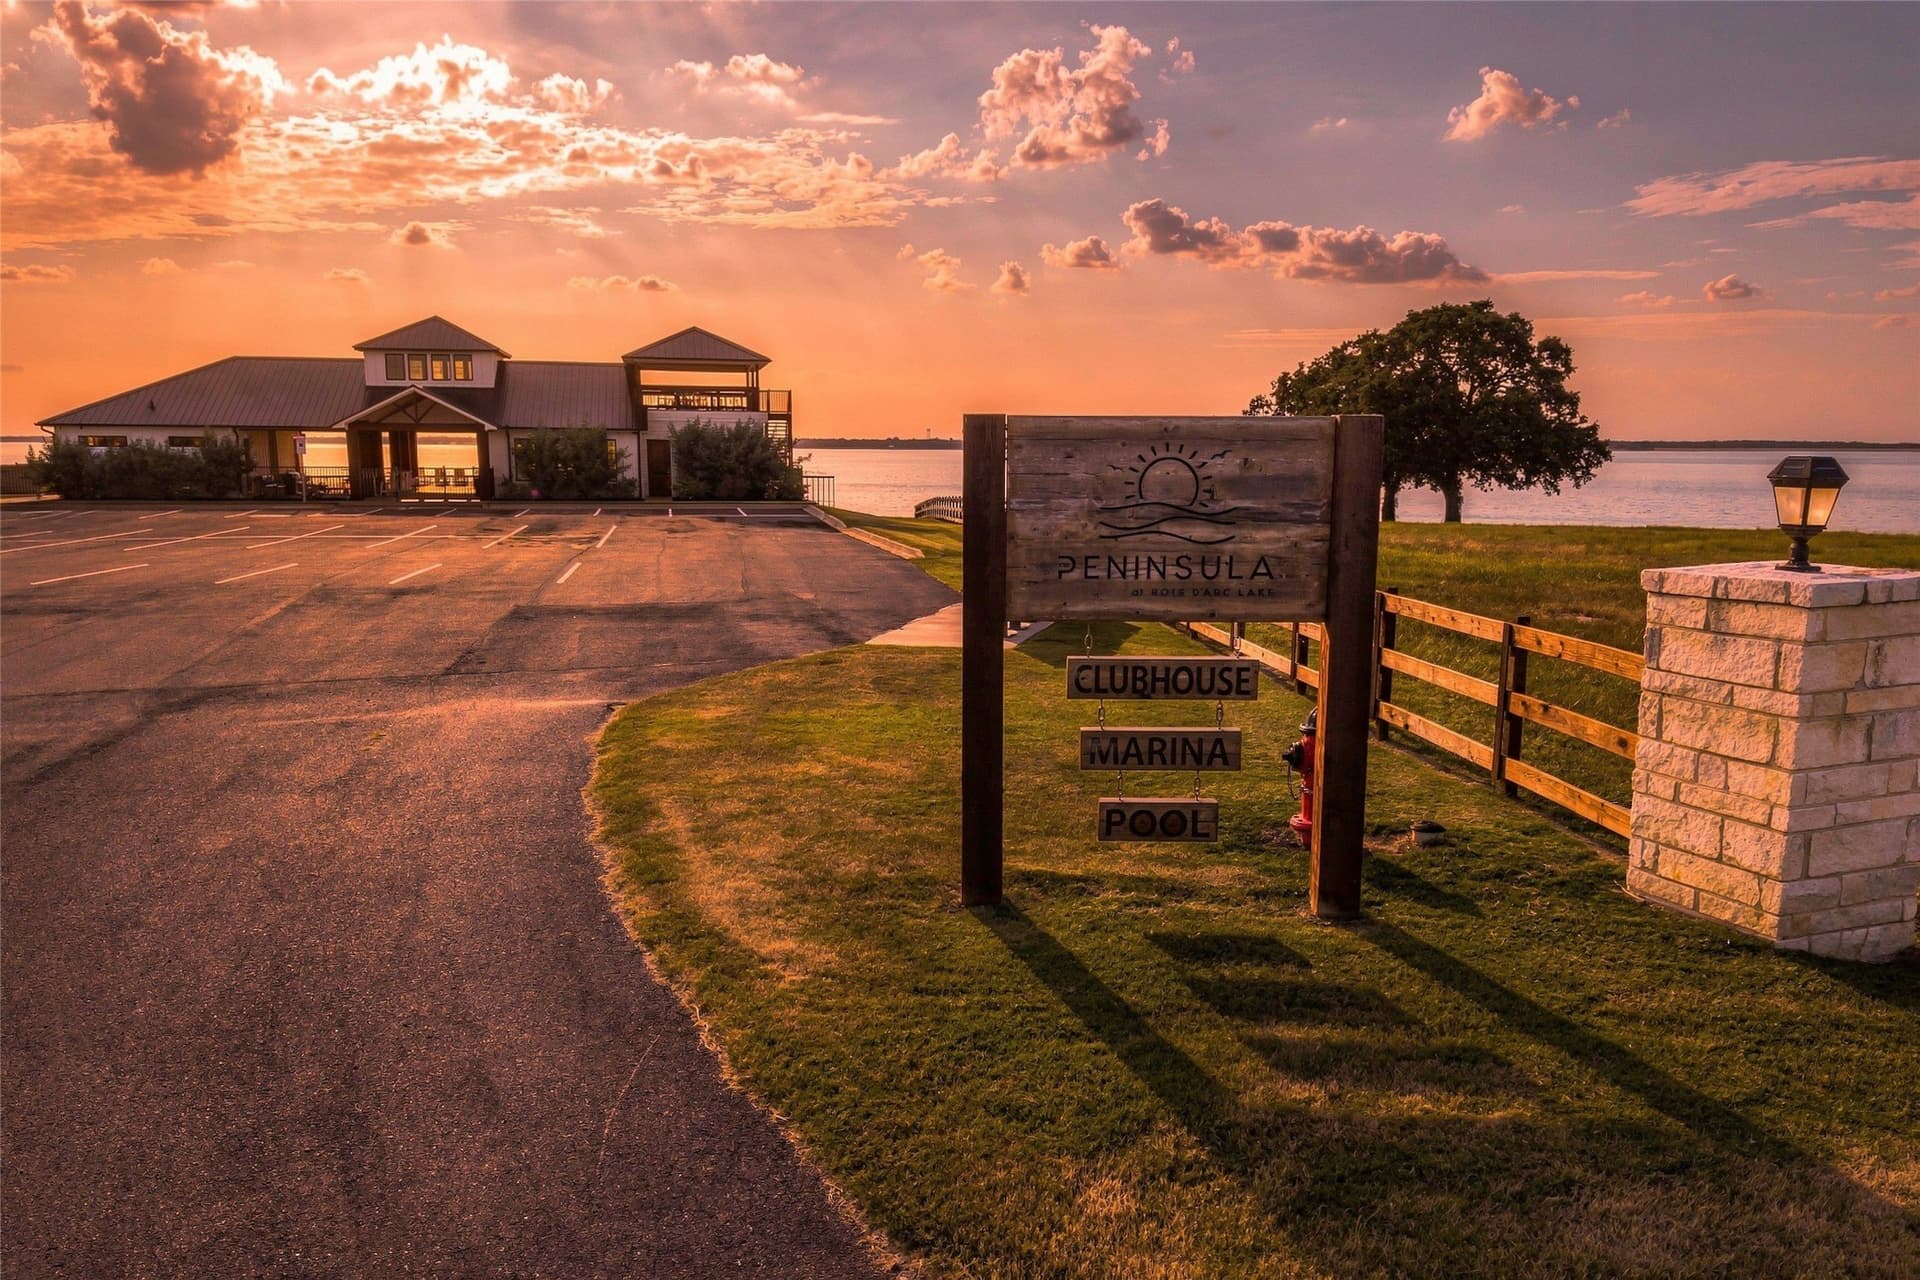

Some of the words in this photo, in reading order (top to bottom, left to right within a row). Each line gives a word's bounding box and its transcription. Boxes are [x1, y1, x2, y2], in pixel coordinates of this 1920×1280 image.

[1058, 555, 1274, 580] PENINSULA
[1074, 664, 1251, 695] CLUBHOUSE
[1089, 737, 1229, 766] MARINA
[1105, 808, 1210, 838] POOL
